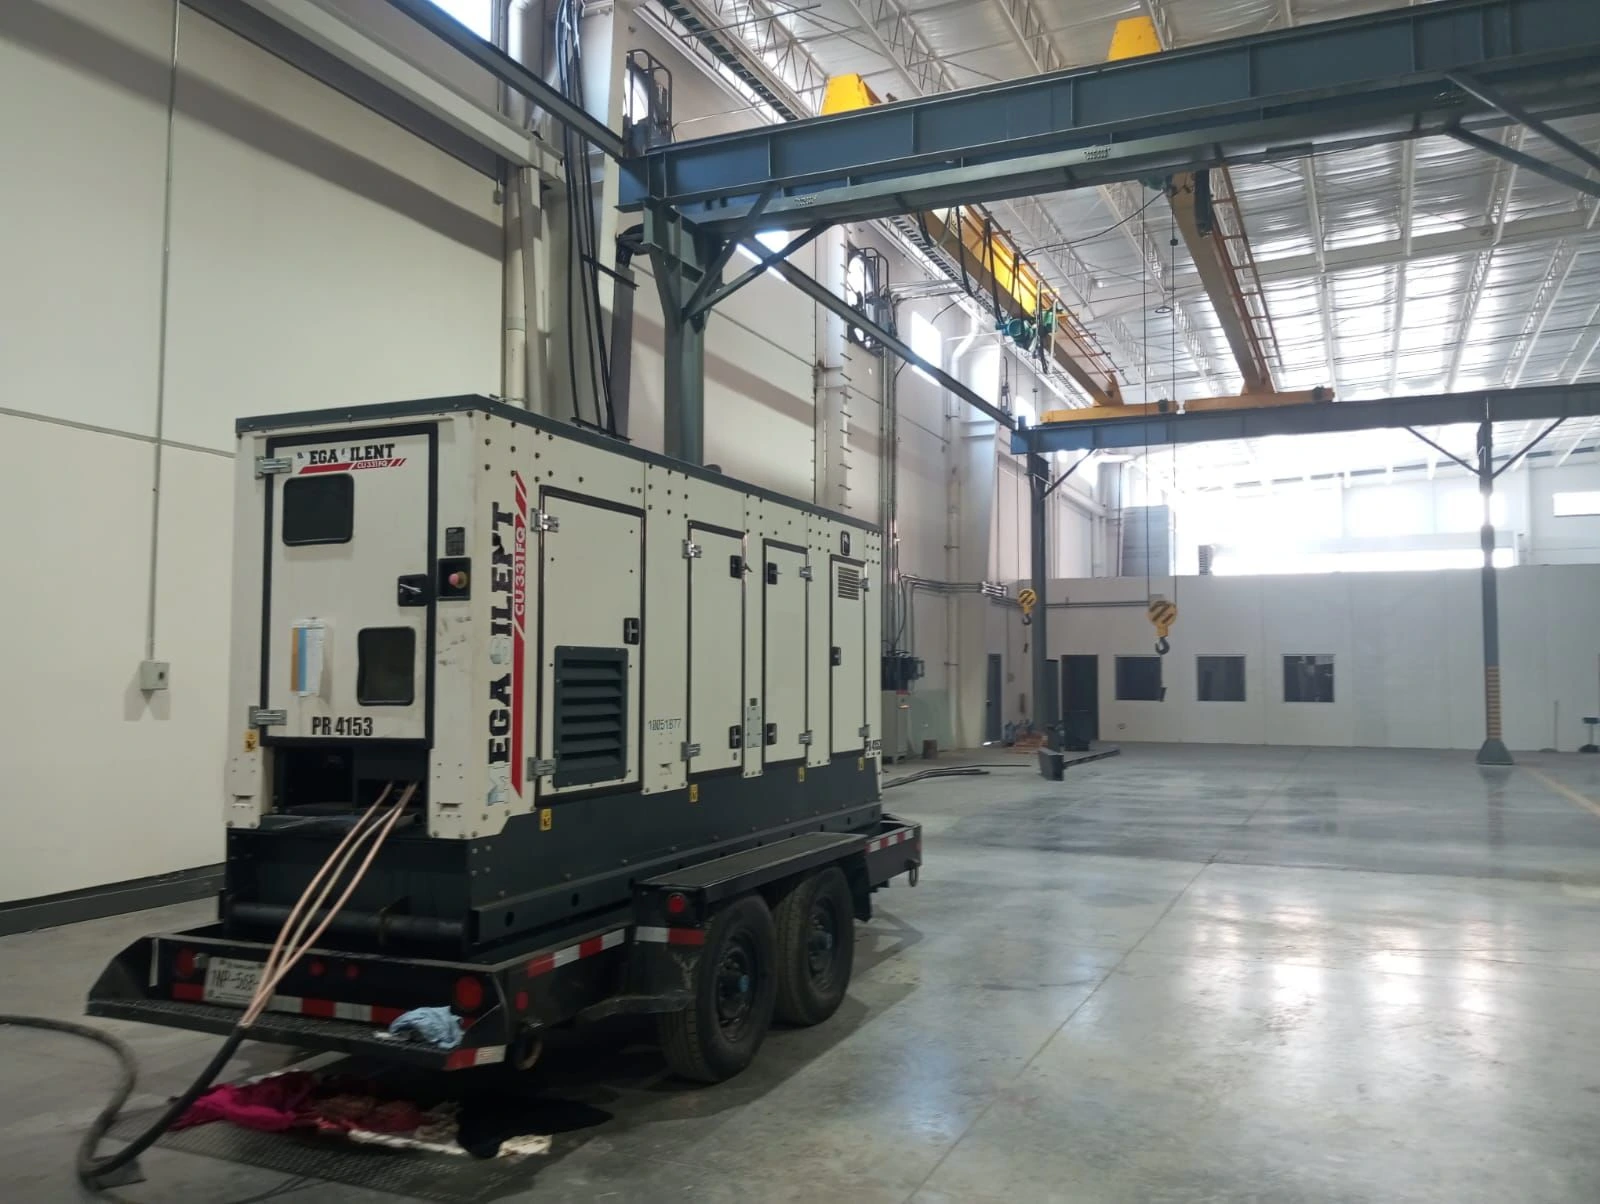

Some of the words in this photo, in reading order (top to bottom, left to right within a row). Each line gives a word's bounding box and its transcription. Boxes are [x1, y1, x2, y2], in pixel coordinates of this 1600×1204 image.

[297, 449, 338, 465] EGA
[341, 443, 395, 461] ILENT
[311, 716, 332, 736] PR
[334, 716, 373, 736] 4153
